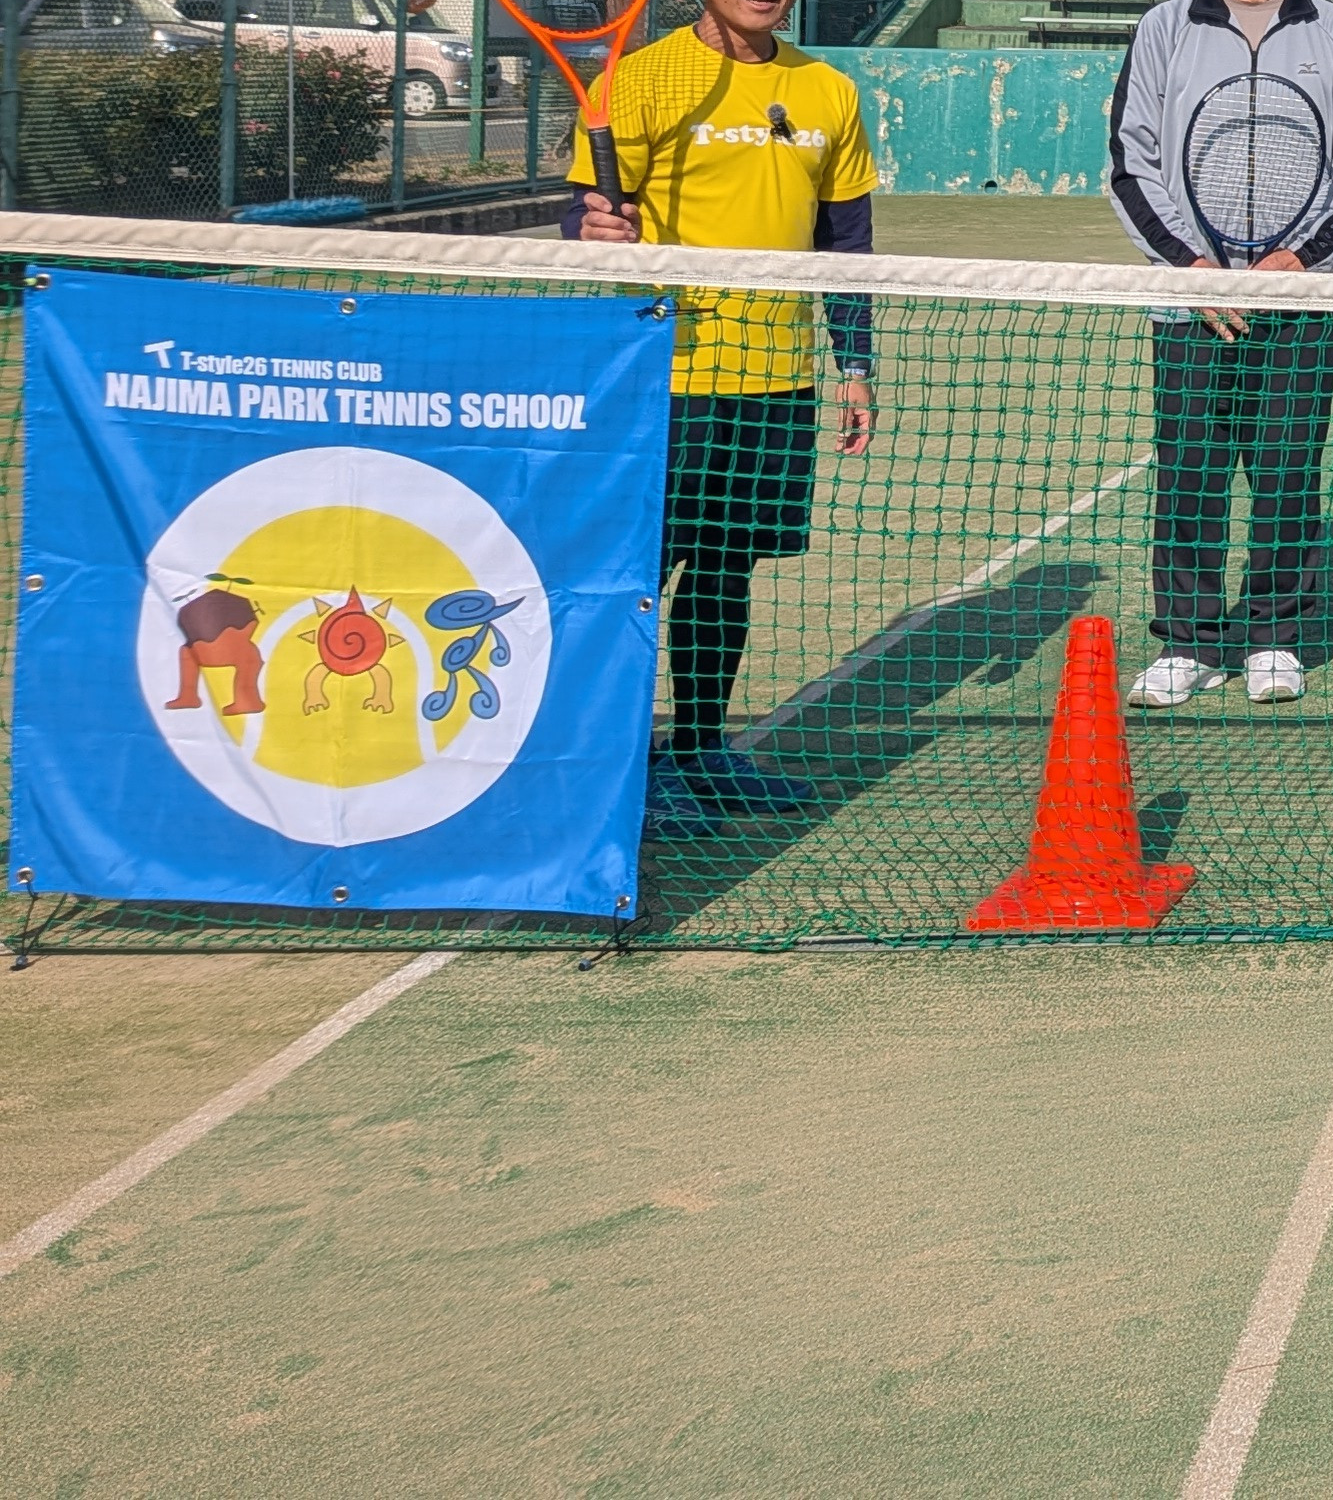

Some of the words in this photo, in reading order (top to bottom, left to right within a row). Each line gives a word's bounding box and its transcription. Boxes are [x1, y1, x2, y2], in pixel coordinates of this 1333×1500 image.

[690, 124, 826, 147] T-sty26
[180, 351, 267, 376] T-style26
[271, 358, 333, 380] TENNIS
[336, 361, 383, 382] CLUB
[105, 371, 232, 417] NAJIMA
[238, 383, 329, 423] PARK
[334, 388, 452, 428] TENNIS
[460, 393, 587, 430] SCHOOL
